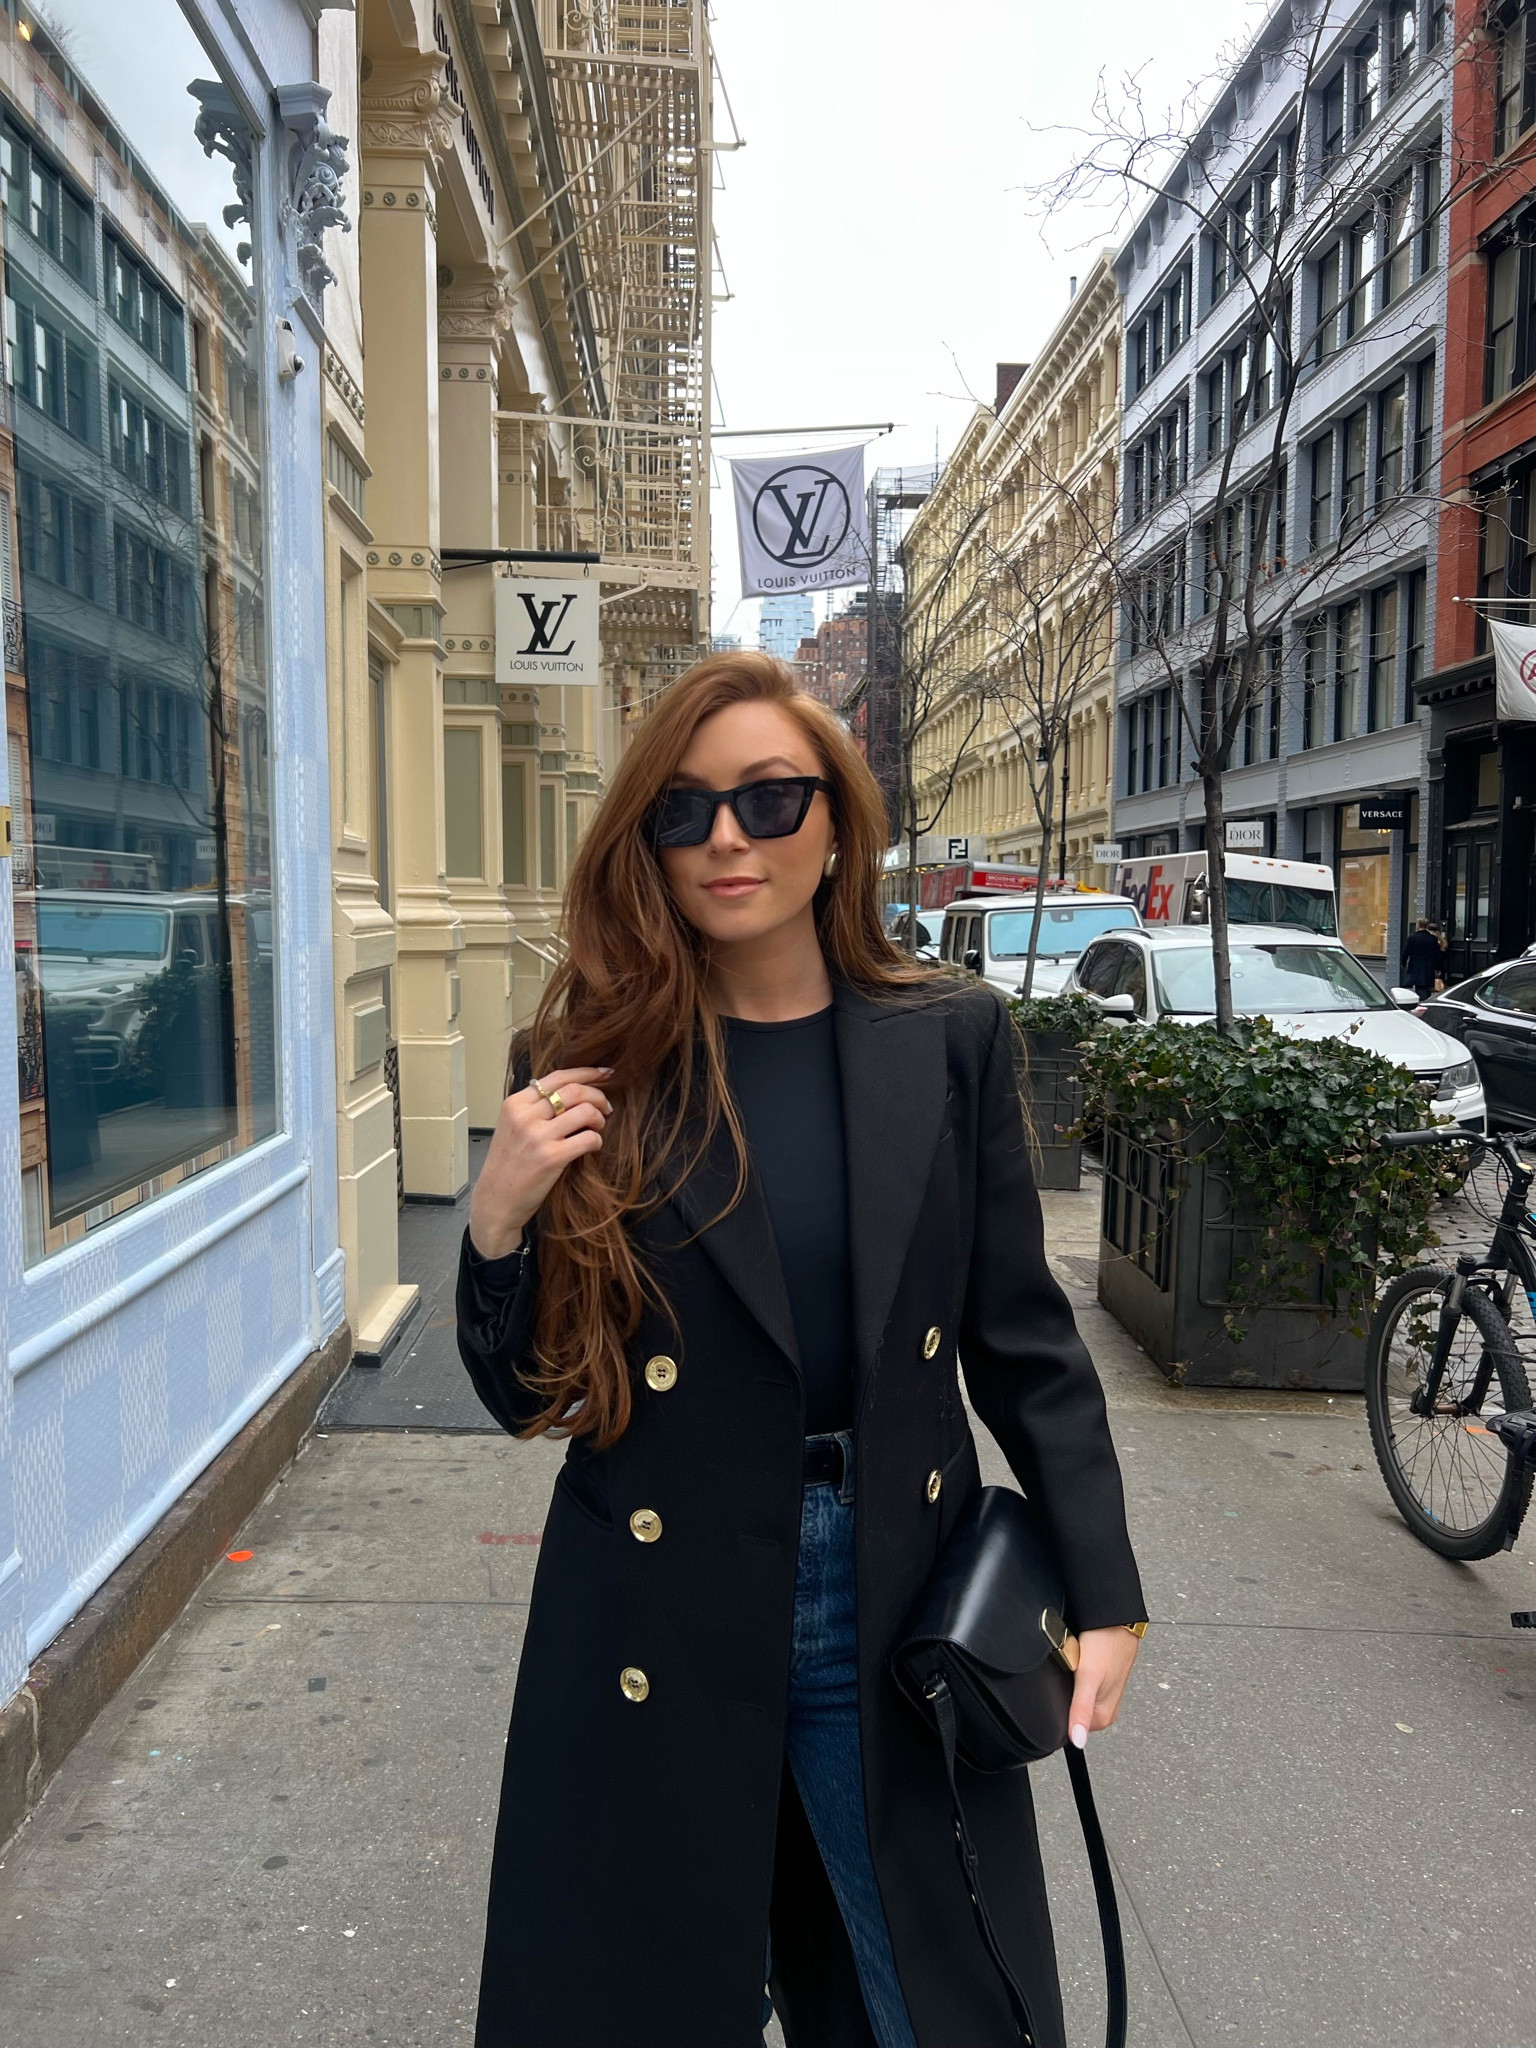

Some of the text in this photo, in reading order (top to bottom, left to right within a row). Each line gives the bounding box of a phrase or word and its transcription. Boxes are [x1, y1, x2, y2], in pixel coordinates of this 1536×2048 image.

[757, 567, 856, 589] LOUIS VUITTON
[510, 660, 584, 672] LOUIS VUITTON
[1361, 810, 1404, 818] VERSACE
[1229, 830, 1261, 840] DIOR
[1095, 850, 1120, 858] DIOR
